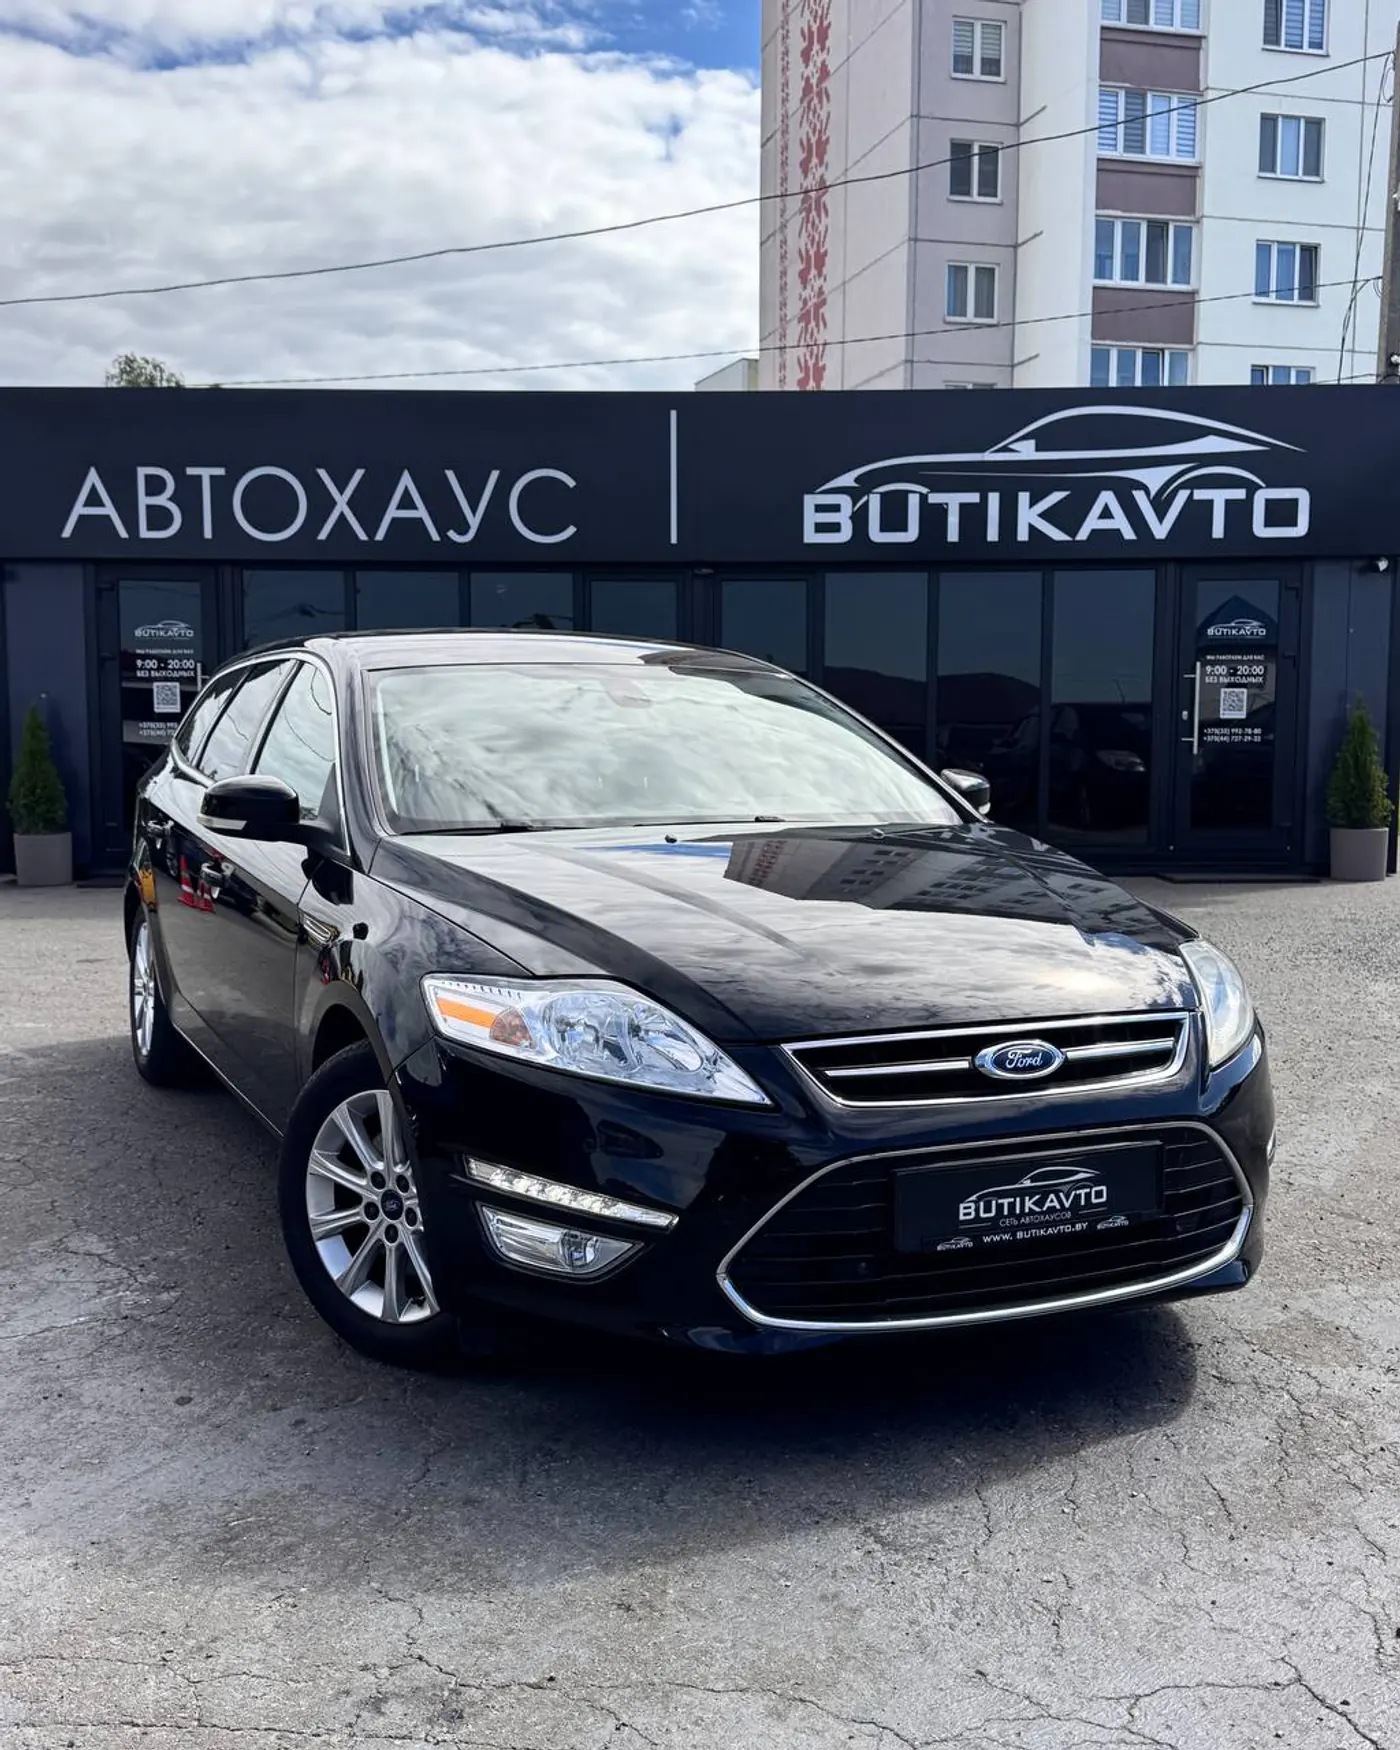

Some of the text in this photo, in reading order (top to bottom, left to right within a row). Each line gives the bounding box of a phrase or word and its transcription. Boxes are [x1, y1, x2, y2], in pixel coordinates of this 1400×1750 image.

[61, 466, 576, 543] АВТОХАУС
[803, 487, 1311, 544] BUTIKAVTO
[134, 629, 194, 637] BUTIKAVTO
[1207, 627, 1266, 636] BUTIKAVTO
[136, 659, 158, 669] 9:00
[167, 659, 195, 669] 20:00
[1205, 664, 1227, 675] 9:00
[1236, 664, 1265, 675] 20:00
[1006, 1049, 1043, 1069] Ford
[958, 1185, 1108, 1221] BUTIKAVTO
[1020, 1211, 1072, 1224] АВТОХАУСОВ
[1016, 1222, 1089, 1239] BUTIKAVTO.BY
